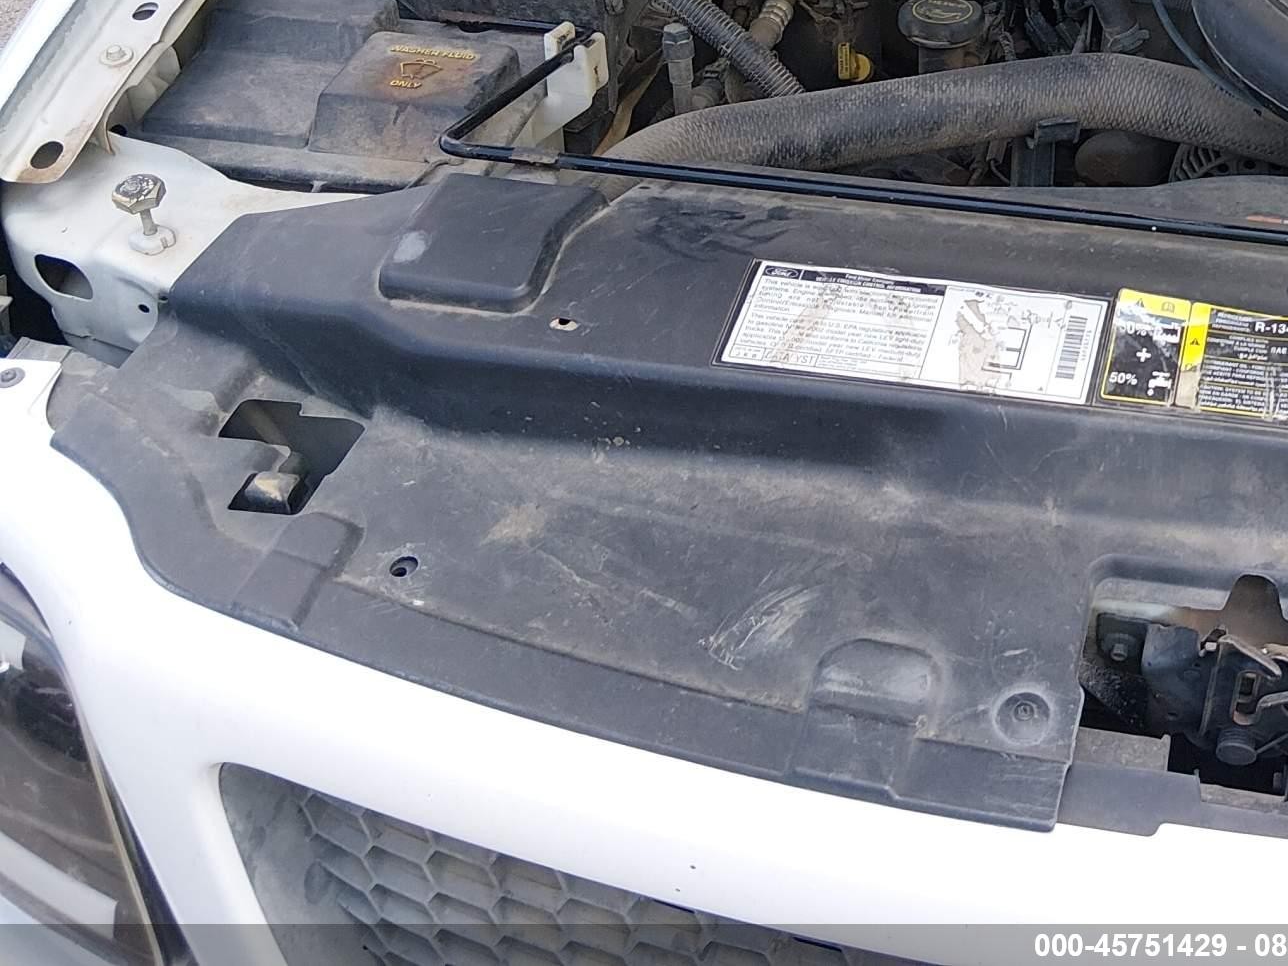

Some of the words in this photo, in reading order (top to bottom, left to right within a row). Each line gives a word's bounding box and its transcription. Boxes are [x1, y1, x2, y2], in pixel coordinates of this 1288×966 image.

[442, 50, 476, 60] FLUID
[390, 80, 422, 88] ONLY
[1108, 371, 1138, 386] 50%
